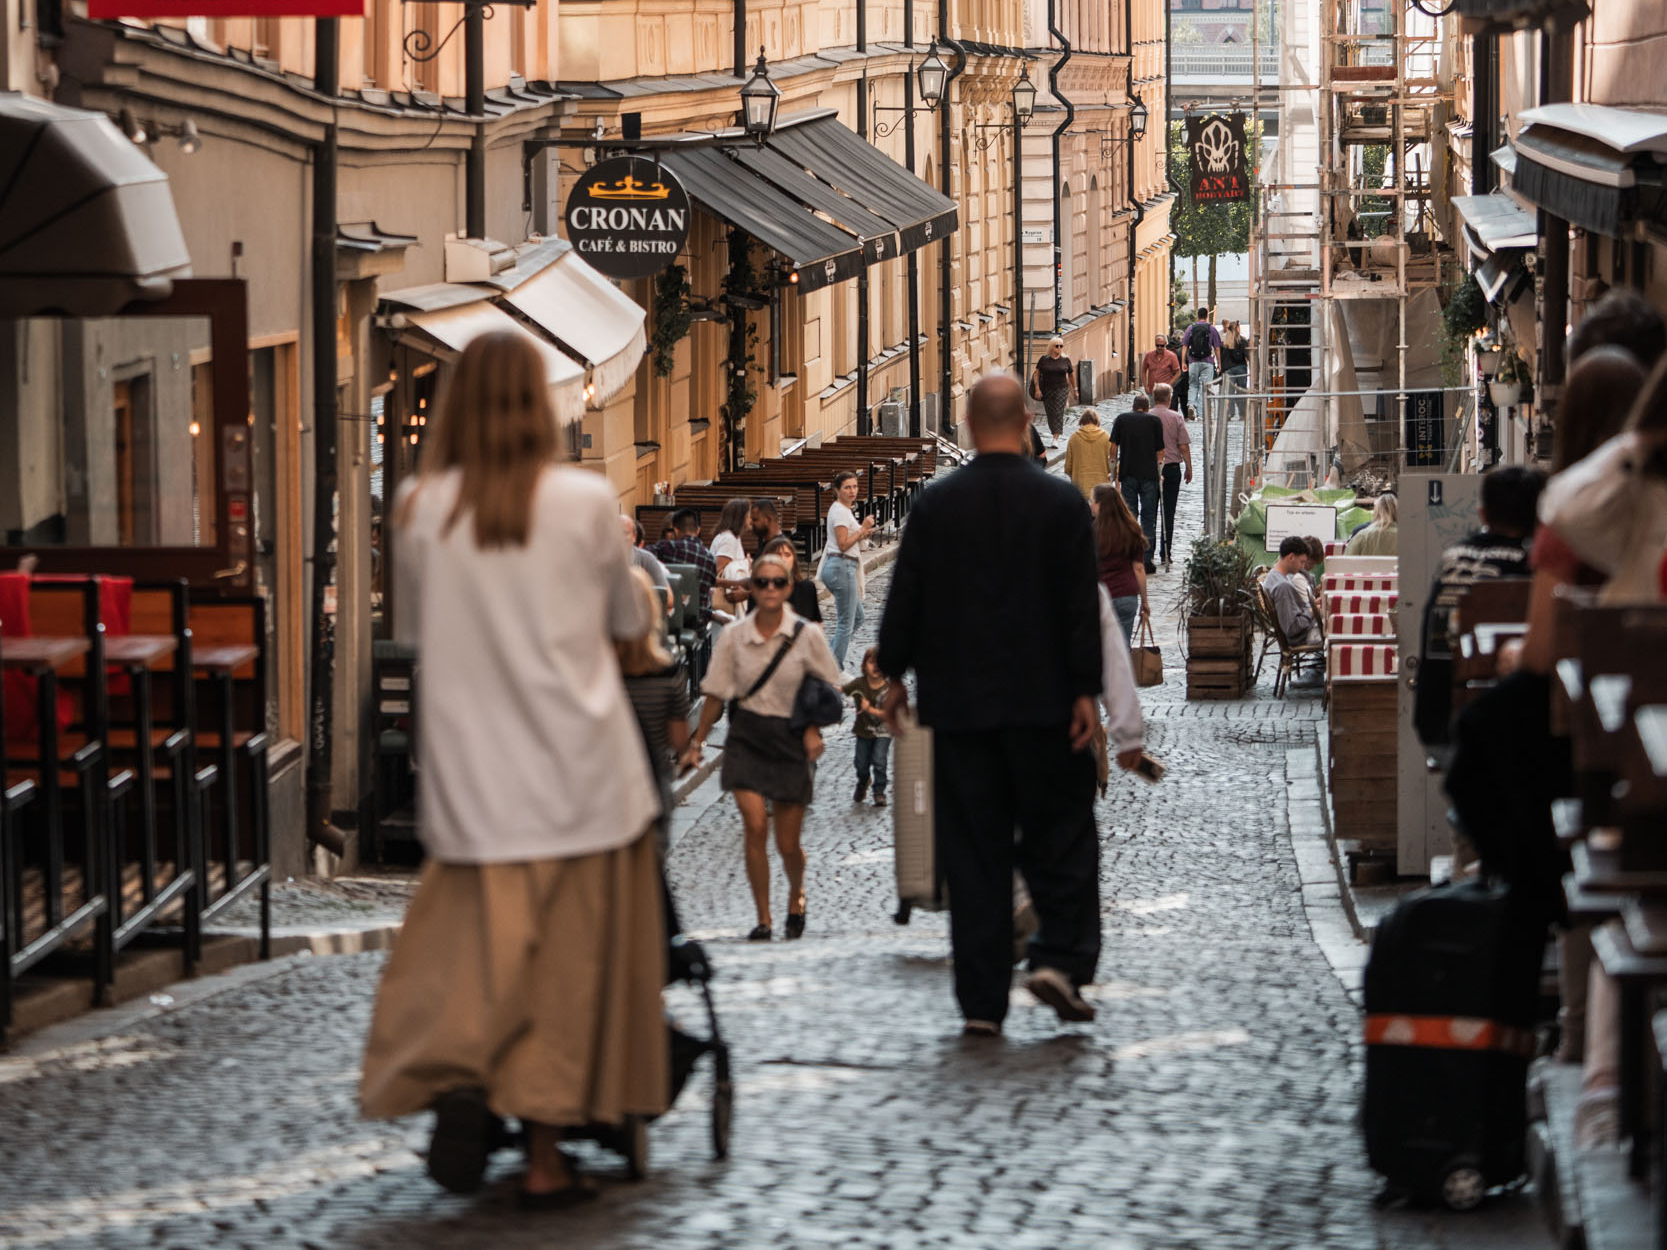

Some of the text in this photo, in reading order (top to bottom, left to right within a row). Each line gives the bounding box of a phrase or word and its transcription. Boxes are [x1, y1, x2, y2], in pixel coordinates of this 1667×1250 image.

[1199, 175, 1240, 191] ANT
[570, 206, 686, 231] CRONAN
[579, 236, 677, 254] CAFÉ & BISTRO
[1418, 399, 1426, 441] INTEROC
